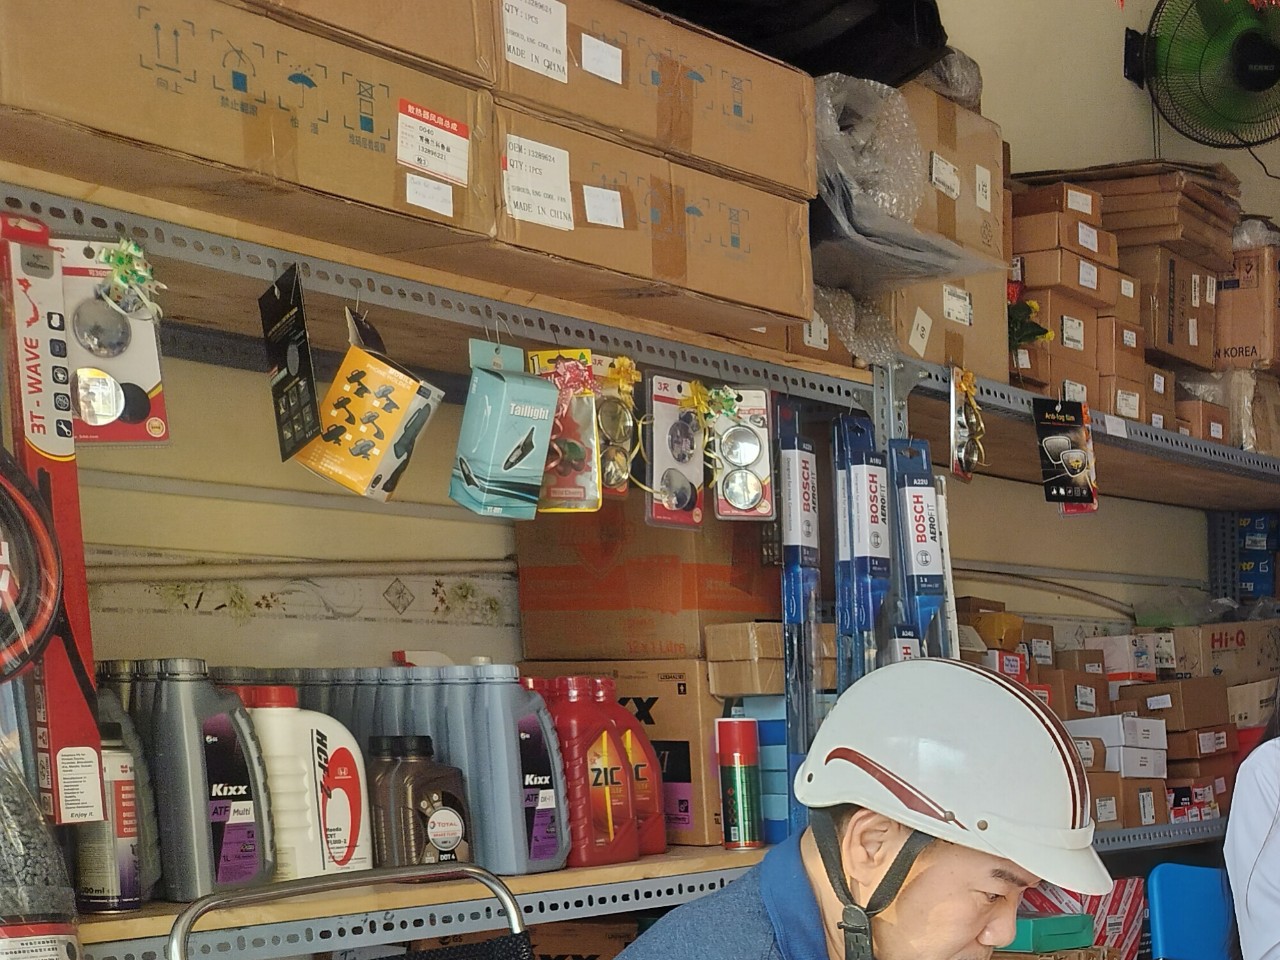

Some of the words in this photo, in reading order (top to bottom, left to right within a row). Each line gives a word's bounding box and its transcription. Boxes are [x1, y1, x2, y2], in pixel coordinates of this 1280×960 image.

[506, 43, 526, 60] MADE
[530, 53, 540, 65] IN
[543, 58, 567, 76] CHINA
[513, 200, 533, 213] MADE
[537, 205, 546, 216] IN
[550, 208, 572, 222] CHINA
[1223, 345, 1258, 358] KOREA
[24, 337, 42, 395] WAVE
[510, 403, 549, 420] Taillight
[801, 459, 811, 513] BOSCH
[869, 473, 879, 525] BOSCH
[912, 494, 928, 544] BOSCH
[926, 503, 938, 543] AEROFIT
[1211, 629, 1246, 650] Hi-Q
[524, 774, 551, 786] Kixx
[590, 766, 622, 787] ZIC
[211, 783, 248, 797] Kixx
[525, 793, 539, 803] ATF
[70, 811, 87, 819] Enjoy
[212, 805, 230, 817] ATF
[232, 807, 251, 817] Multi
